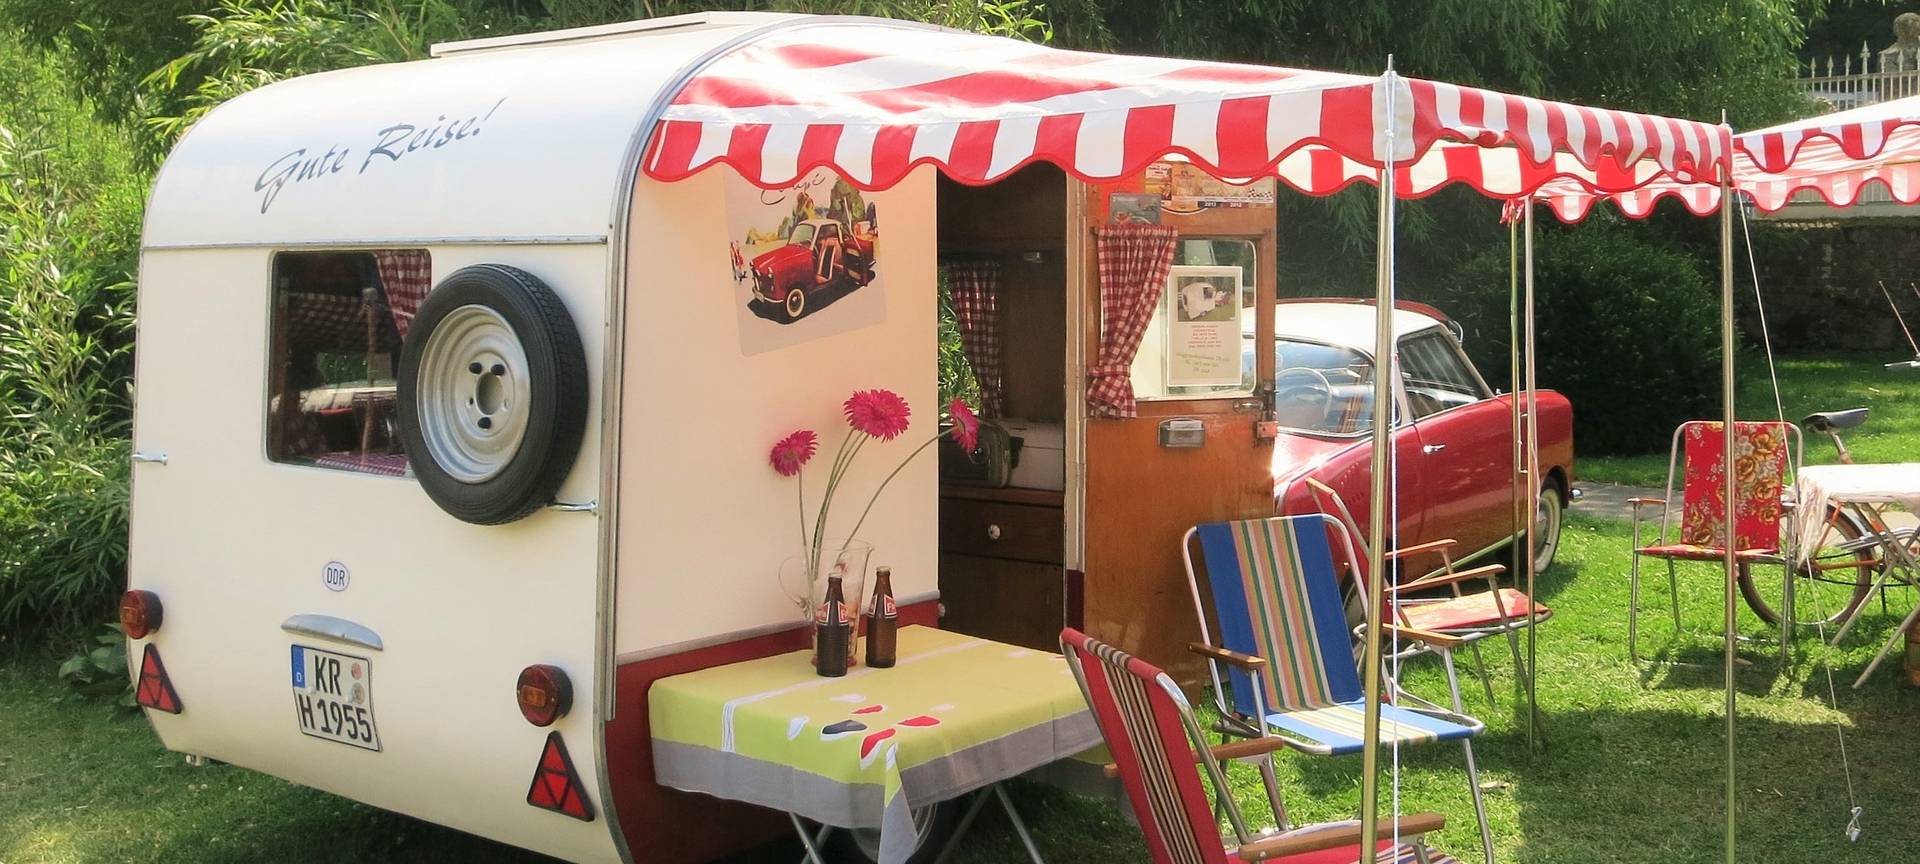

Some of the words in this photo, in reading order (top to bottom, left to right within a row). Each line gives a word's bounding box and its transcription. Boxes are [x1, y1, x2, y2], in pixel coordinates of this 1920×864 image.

[254, 144, 349, 214] Gute
[358, 96, 508, 175] Reise!
[326, 567, 345, 588] DDR
[296, 672, 302, 682] D
[314, 654, 342, 696] KR
[298, 693, 315, 730] H
[317, 698, 372, 743] 1955
